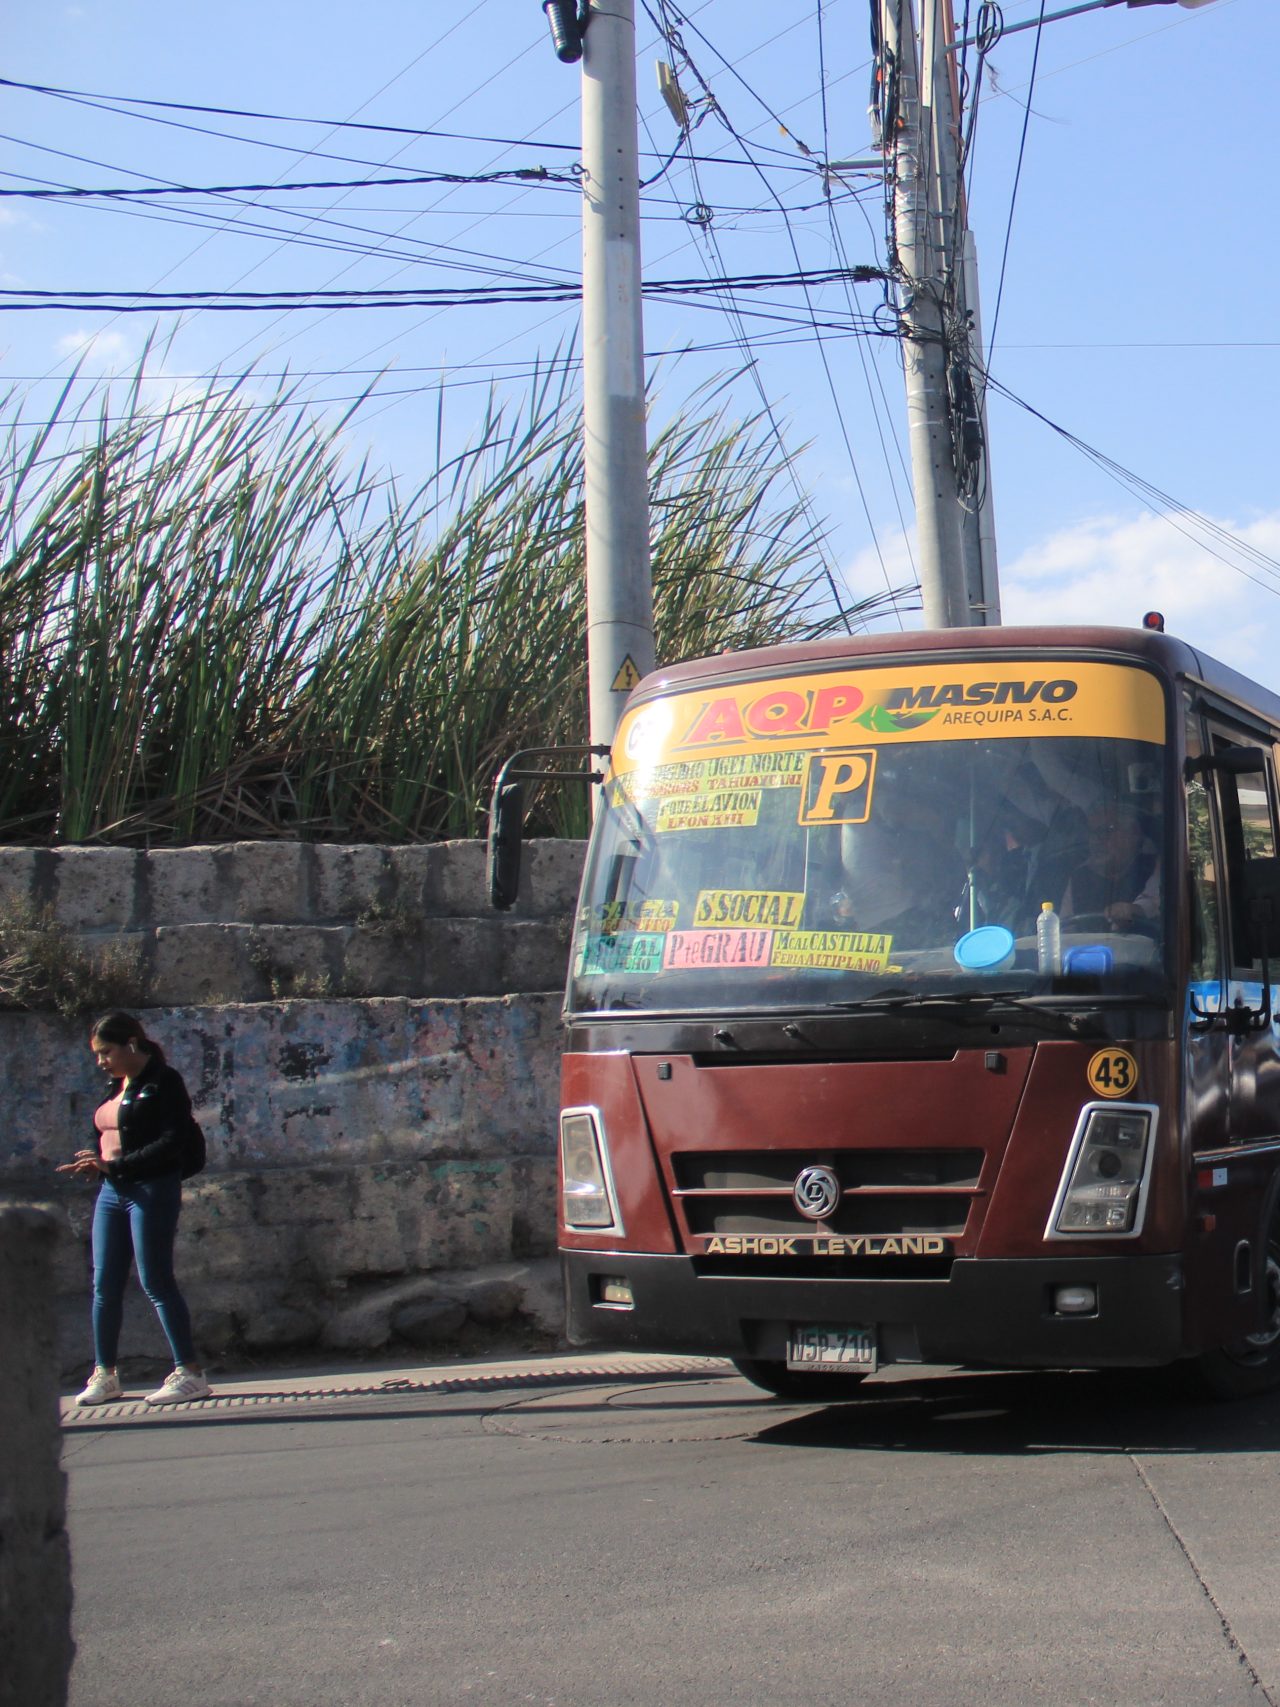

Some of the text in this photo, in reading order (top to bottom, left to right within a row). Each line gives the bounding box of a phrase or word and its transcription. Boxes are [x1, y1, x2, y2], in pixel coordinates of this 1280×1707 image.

[684, 685, 864, 744] AQP
[884, 679, 1078, 709] MASIVO
[943, 708, 1073, 725] AREQUIPA S.A.C.
[750, 752, 804, 775] NORTE
[806, 756, 868, 818] P
[709, 792, 759, 813] AVION
[1095, 1056, 1130, 1089] 43
[707, 1237, 944, 1255] ASHOK LEYLAND
